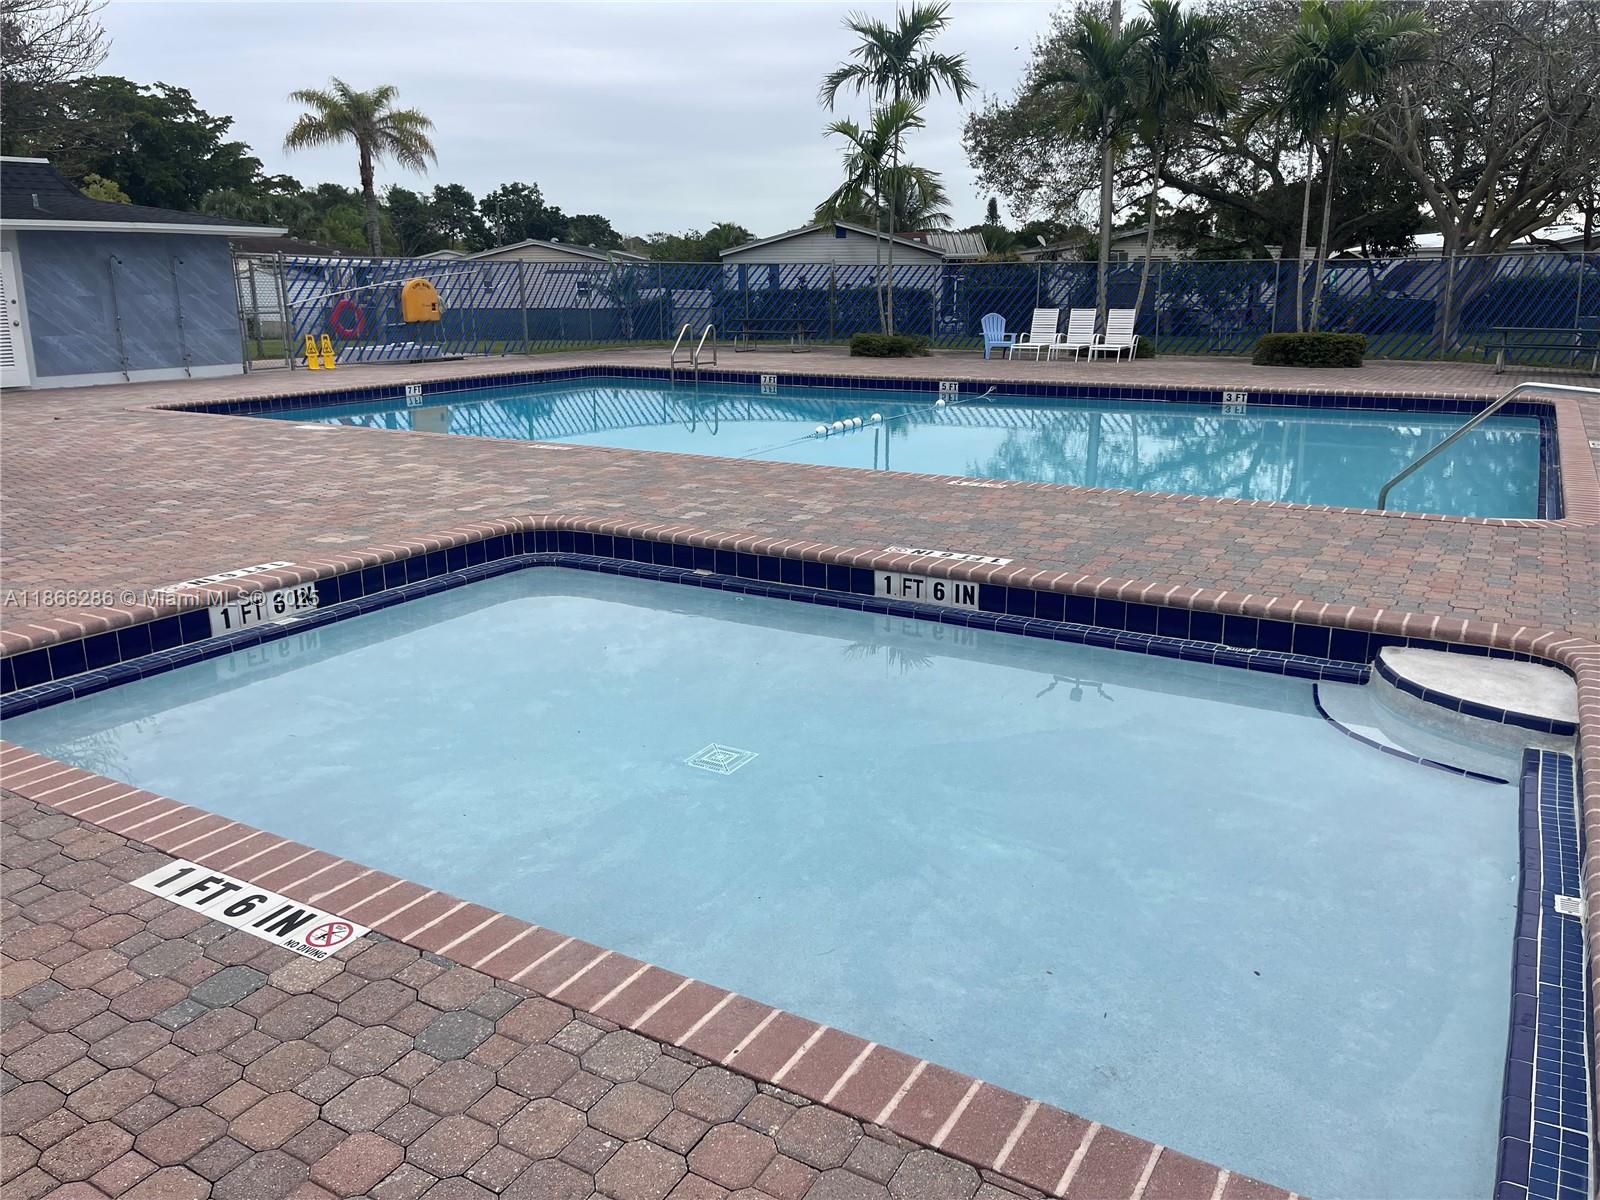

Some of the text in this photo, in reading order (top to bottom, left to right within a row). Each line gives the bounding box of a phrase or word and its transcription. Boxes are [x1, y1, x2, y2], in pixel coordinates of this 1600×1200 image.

[408, 386, 412, 394] 7
[942, 383, 957, 391] 5 FT
[1226, 393, 1247, 402] 3 FT
[884, 575, 975, 606] 1 FT 6 IN
[220, 607, 231, 630] 1
[153, 867, 318, 938] 1 FT 6 IN
[283, 939, 327, 959] NO DIVING
